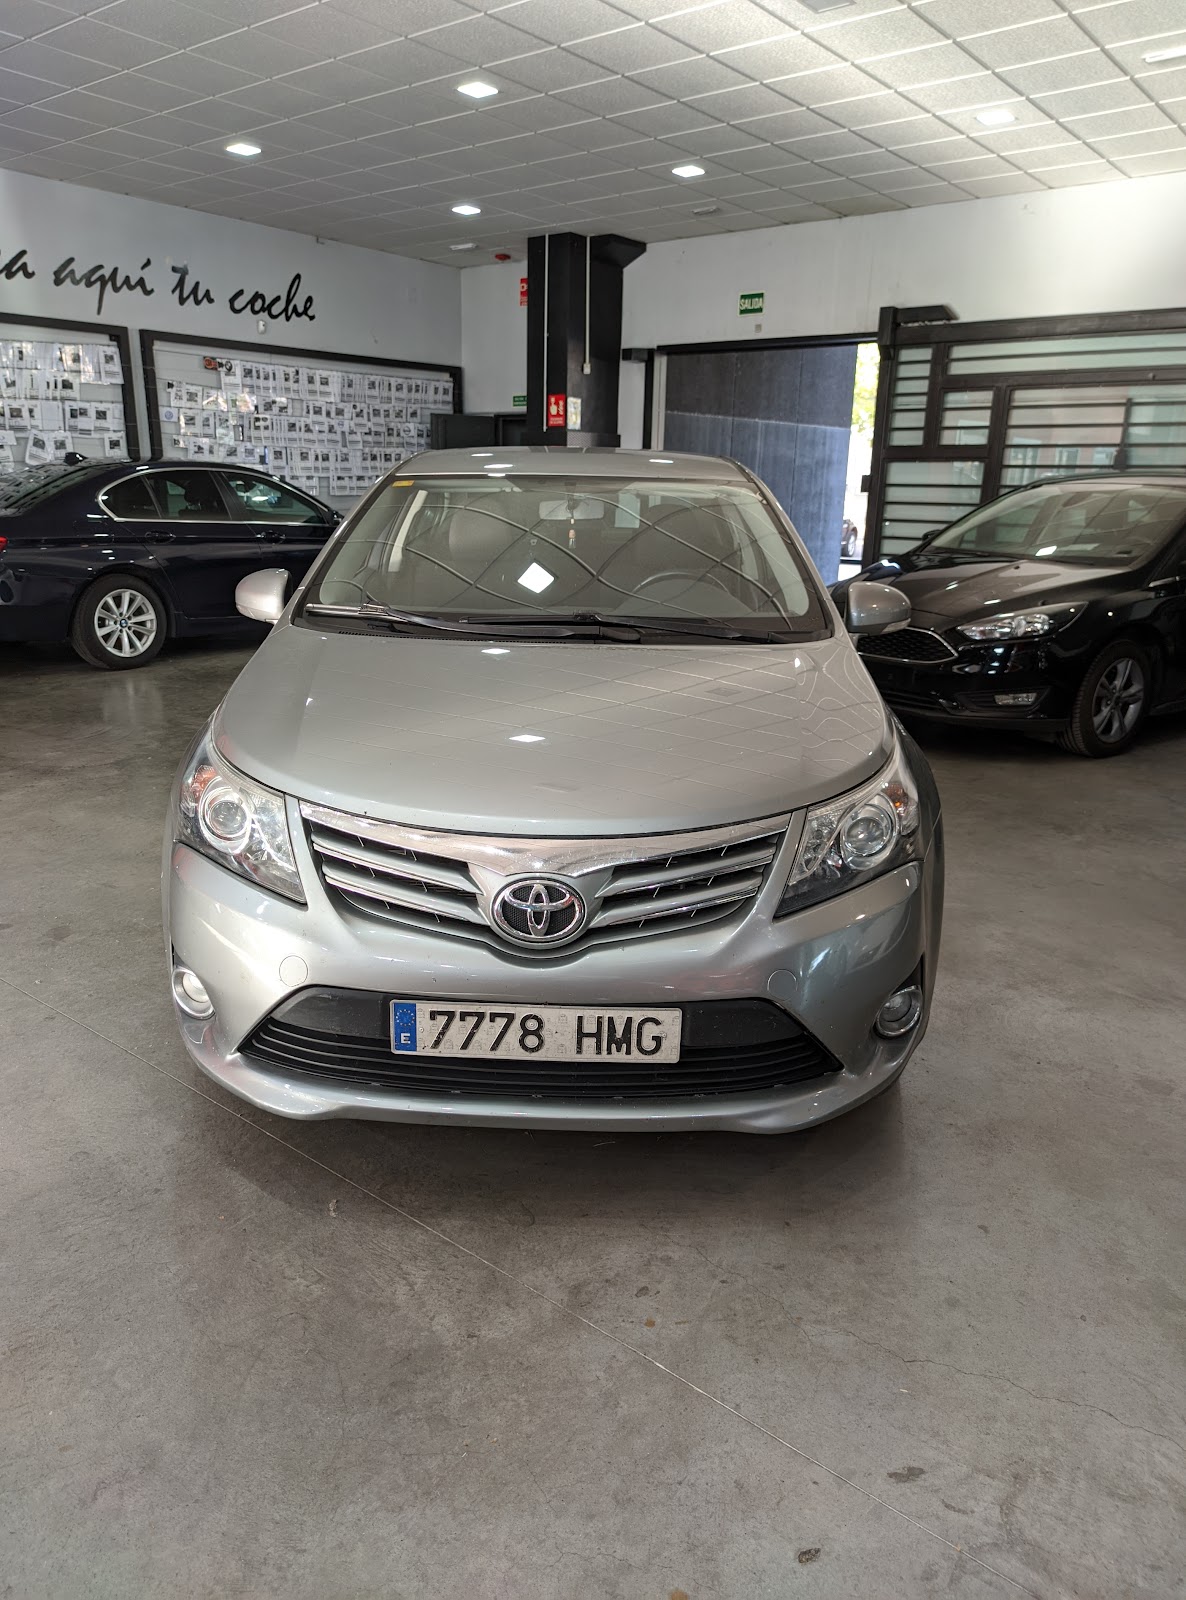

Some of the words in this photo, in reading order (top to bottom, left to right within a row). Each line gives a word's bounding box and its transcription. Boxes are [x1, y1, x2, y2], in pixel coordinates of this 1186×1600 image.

[53, 257, 155, 316] aquí
[171, 264, 215, 306] tu
[229, 272, 316, 322] coche
[740, 297, 763, 310] SALIDA
[400, 1032, 411, 1044] E
[429, 1009, 545, 1053] 7778
[576, 1014, 663, 1056] HMG
